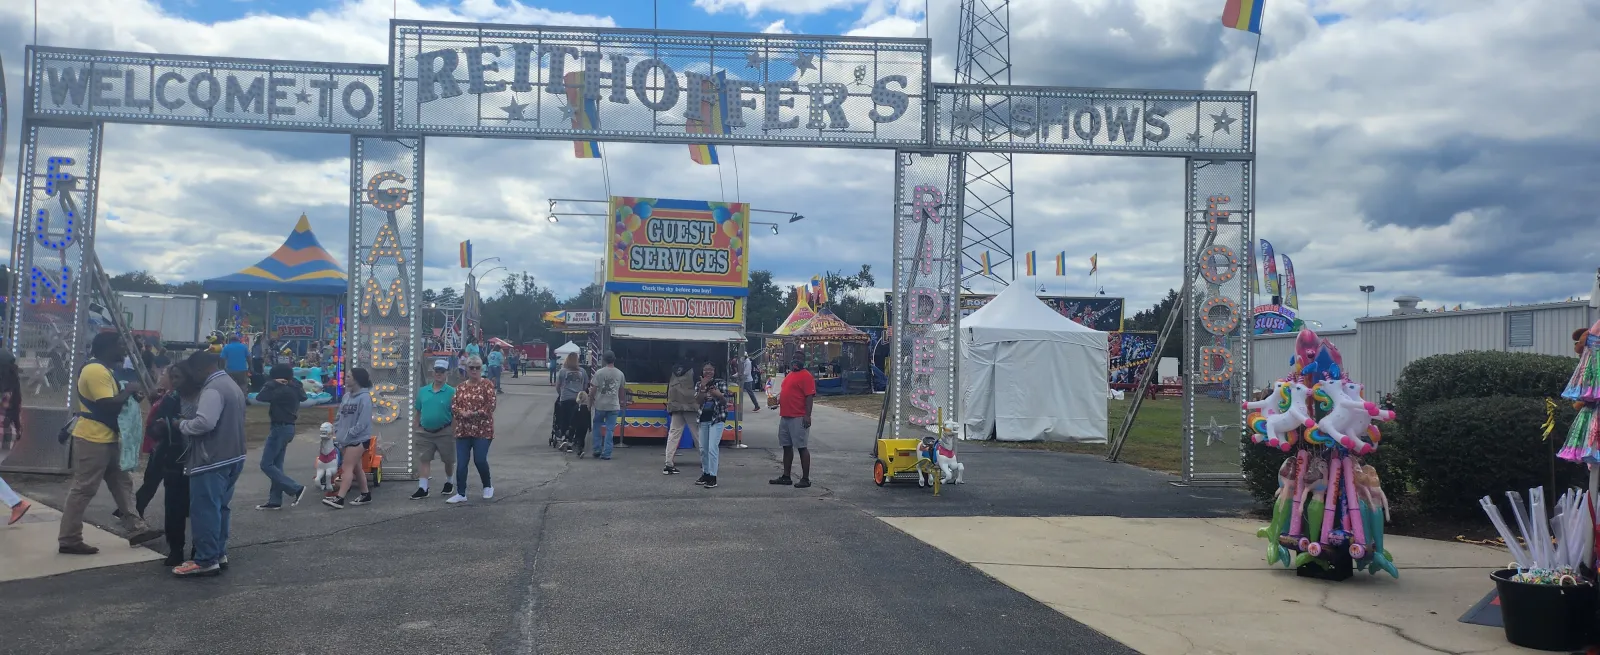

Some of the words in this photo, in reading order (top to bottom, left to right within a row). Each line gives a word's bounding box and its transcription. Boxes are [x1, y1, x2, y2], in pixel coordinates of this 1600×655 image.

[46, 67, 297, 116] WELCOME
[310, 79, 375, 118] TO
[415, 42, 909, 130] REITHOFFER'S
[1010, 102, 1171, 143] SHOWS
[31, 156, 75, 306] FUN
[647, 217, 716, 246] GUEST
[629, 246, 729, 274] SERVICES
[360, 170, 410, 425] GAMES
[620, 297, 688, 317] WRISTBAND
[687, 299, 735, 318] STATION
[908, 184, 945, 428] RIDES
[965, 298, 989, 308] ROC
[1199, 195, 1240, 384] FOOD
[1255, 317, 1286, 330] SLUSH
